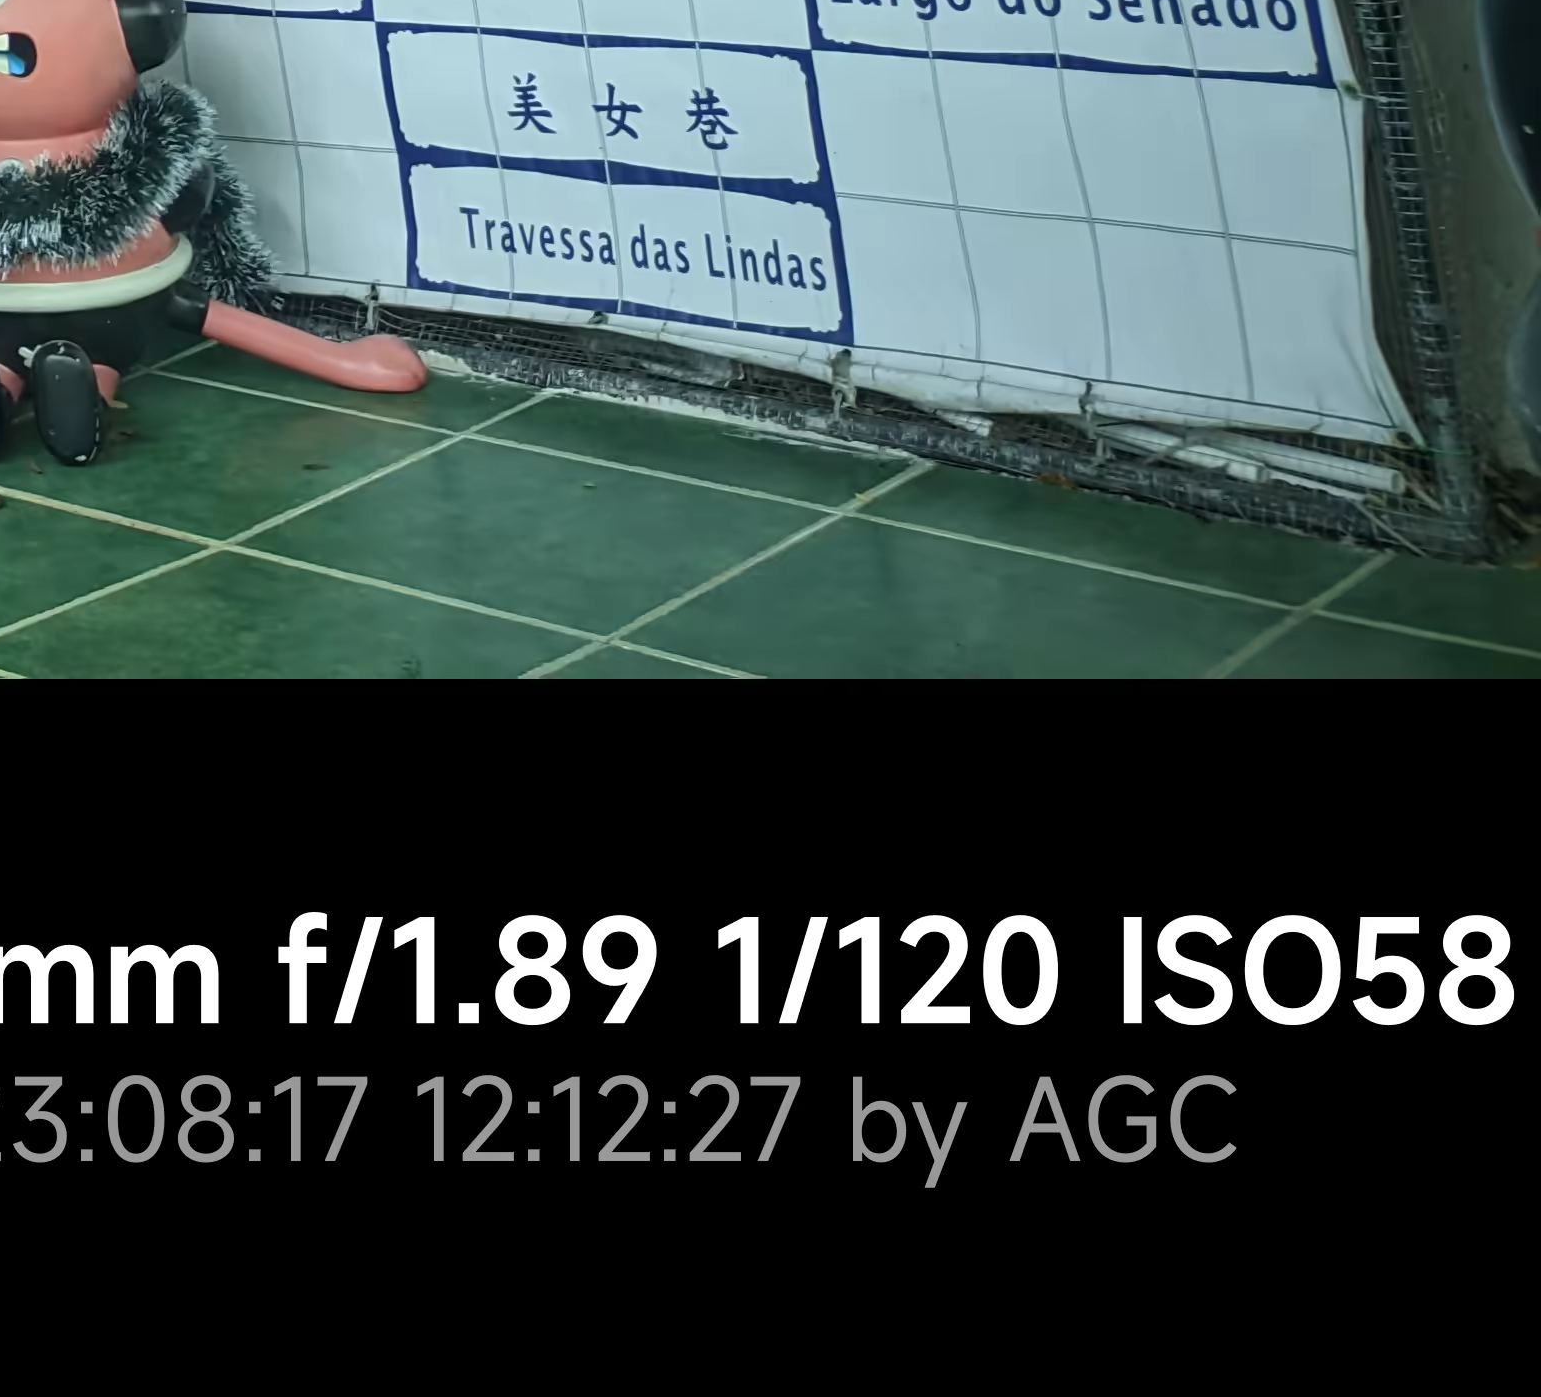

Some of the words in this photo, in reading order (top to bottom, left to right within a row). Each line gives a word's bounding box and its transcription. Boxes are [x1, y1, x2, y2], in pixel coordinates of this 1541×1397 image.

[507, 72, 739, 150] 美女巷
[459, 206, 616, 266] Travessa
[631, 224, 690, 274] das
[704, 232, 828, 291] Lindas
